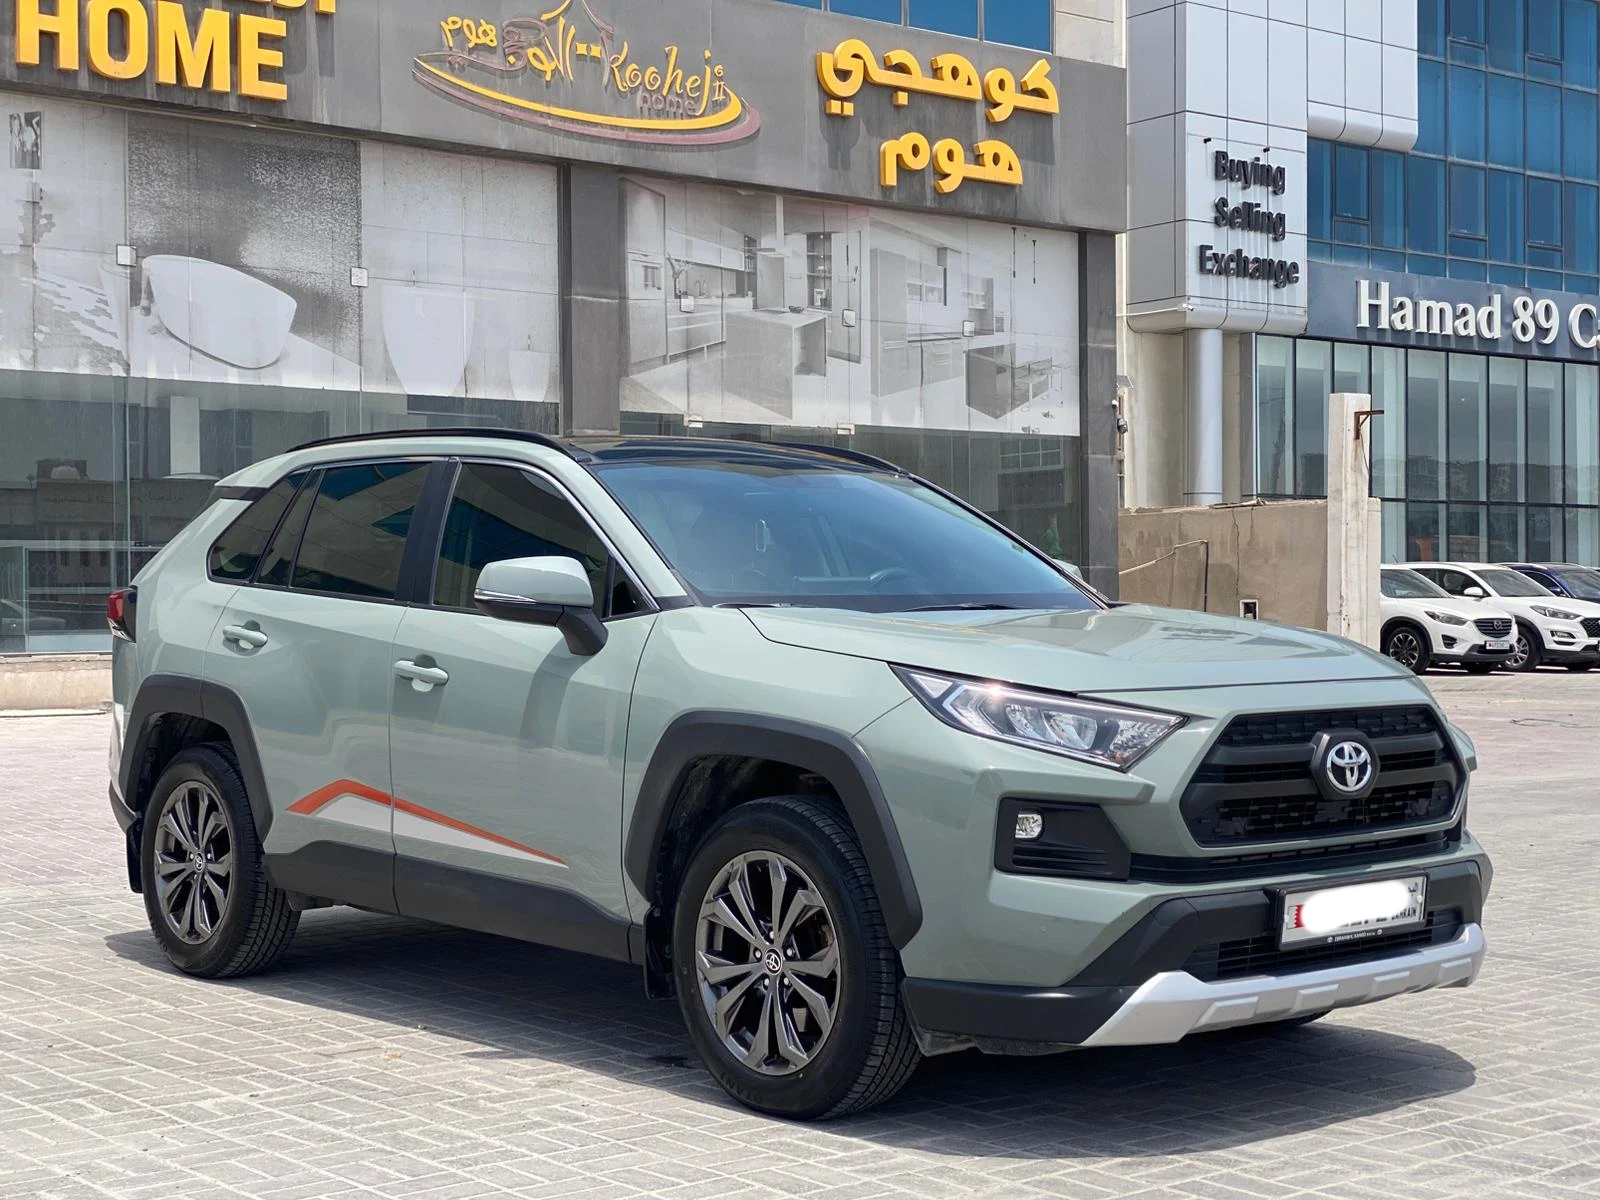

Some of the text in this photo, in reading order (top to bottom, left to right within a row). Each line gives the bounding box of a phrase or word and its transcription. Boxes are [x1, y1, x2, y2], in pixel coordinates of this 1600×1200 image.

[16, 0, 288, 100] HOME
[440, 16, 498, 48] هوم
[817, 39, 1060, 123] كوهجي
[880, 131, 1023, 194] هوم
[1214, 150, 1286, 195] Buying
[1214, 197, 1286, 242] Selling
[1198, 244, 1300, 289] Exchange
[1356, 279, 1600, 349] Hamad 89 C
